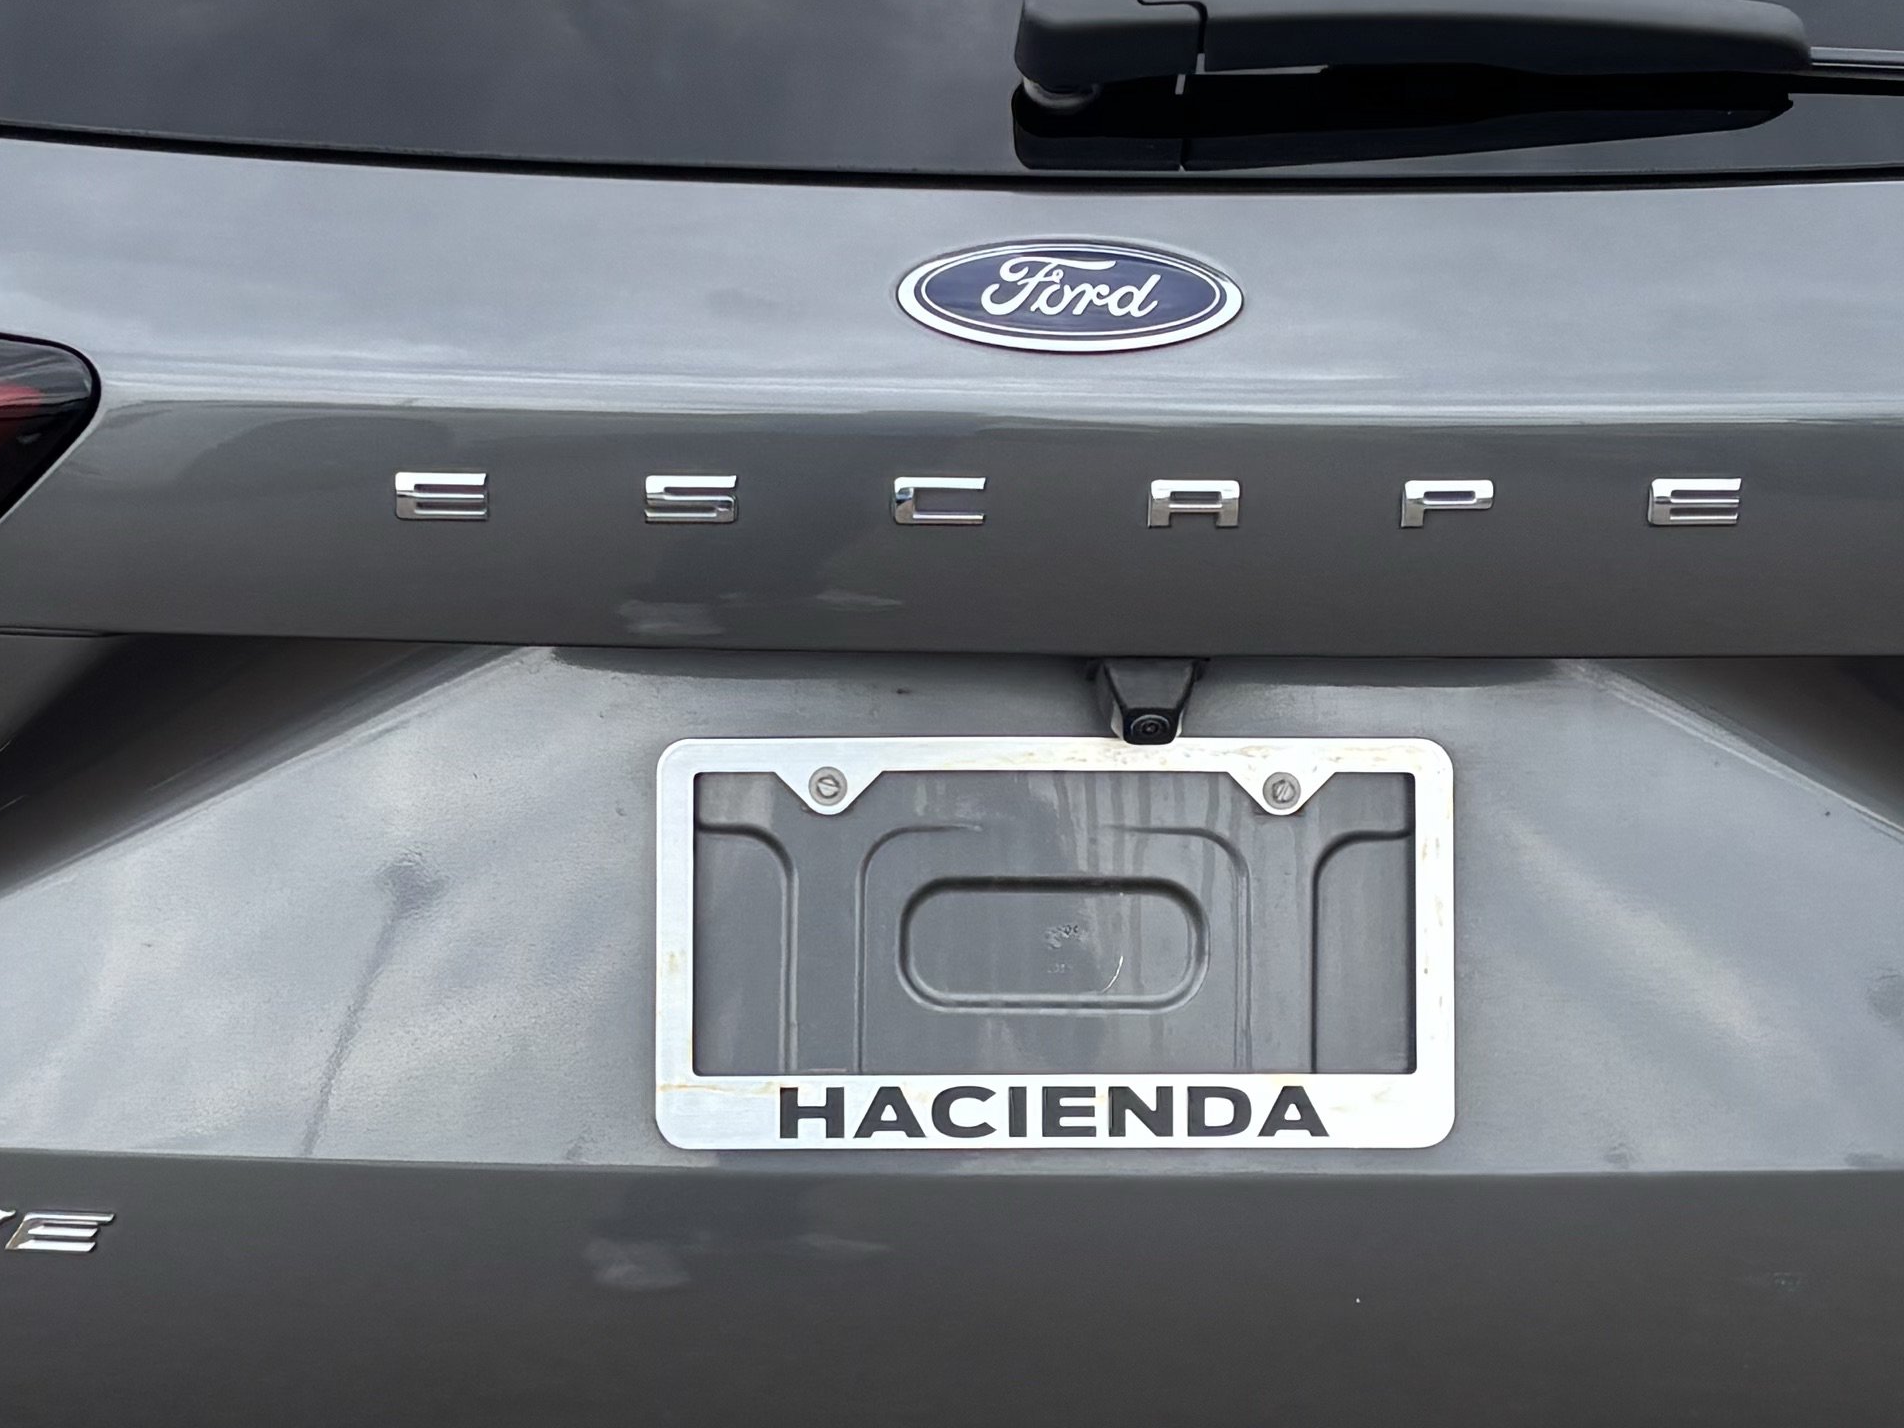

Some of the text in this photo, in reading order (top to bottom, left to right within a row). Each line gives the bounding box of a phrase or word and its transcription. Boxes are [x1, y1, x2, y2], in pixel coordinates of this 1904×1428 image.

[981, 256, 1161, 318] Ford
[394, 471, 1742, 528] ESCAPE
[778, 1085, 1329, 1139] HACIENDA
